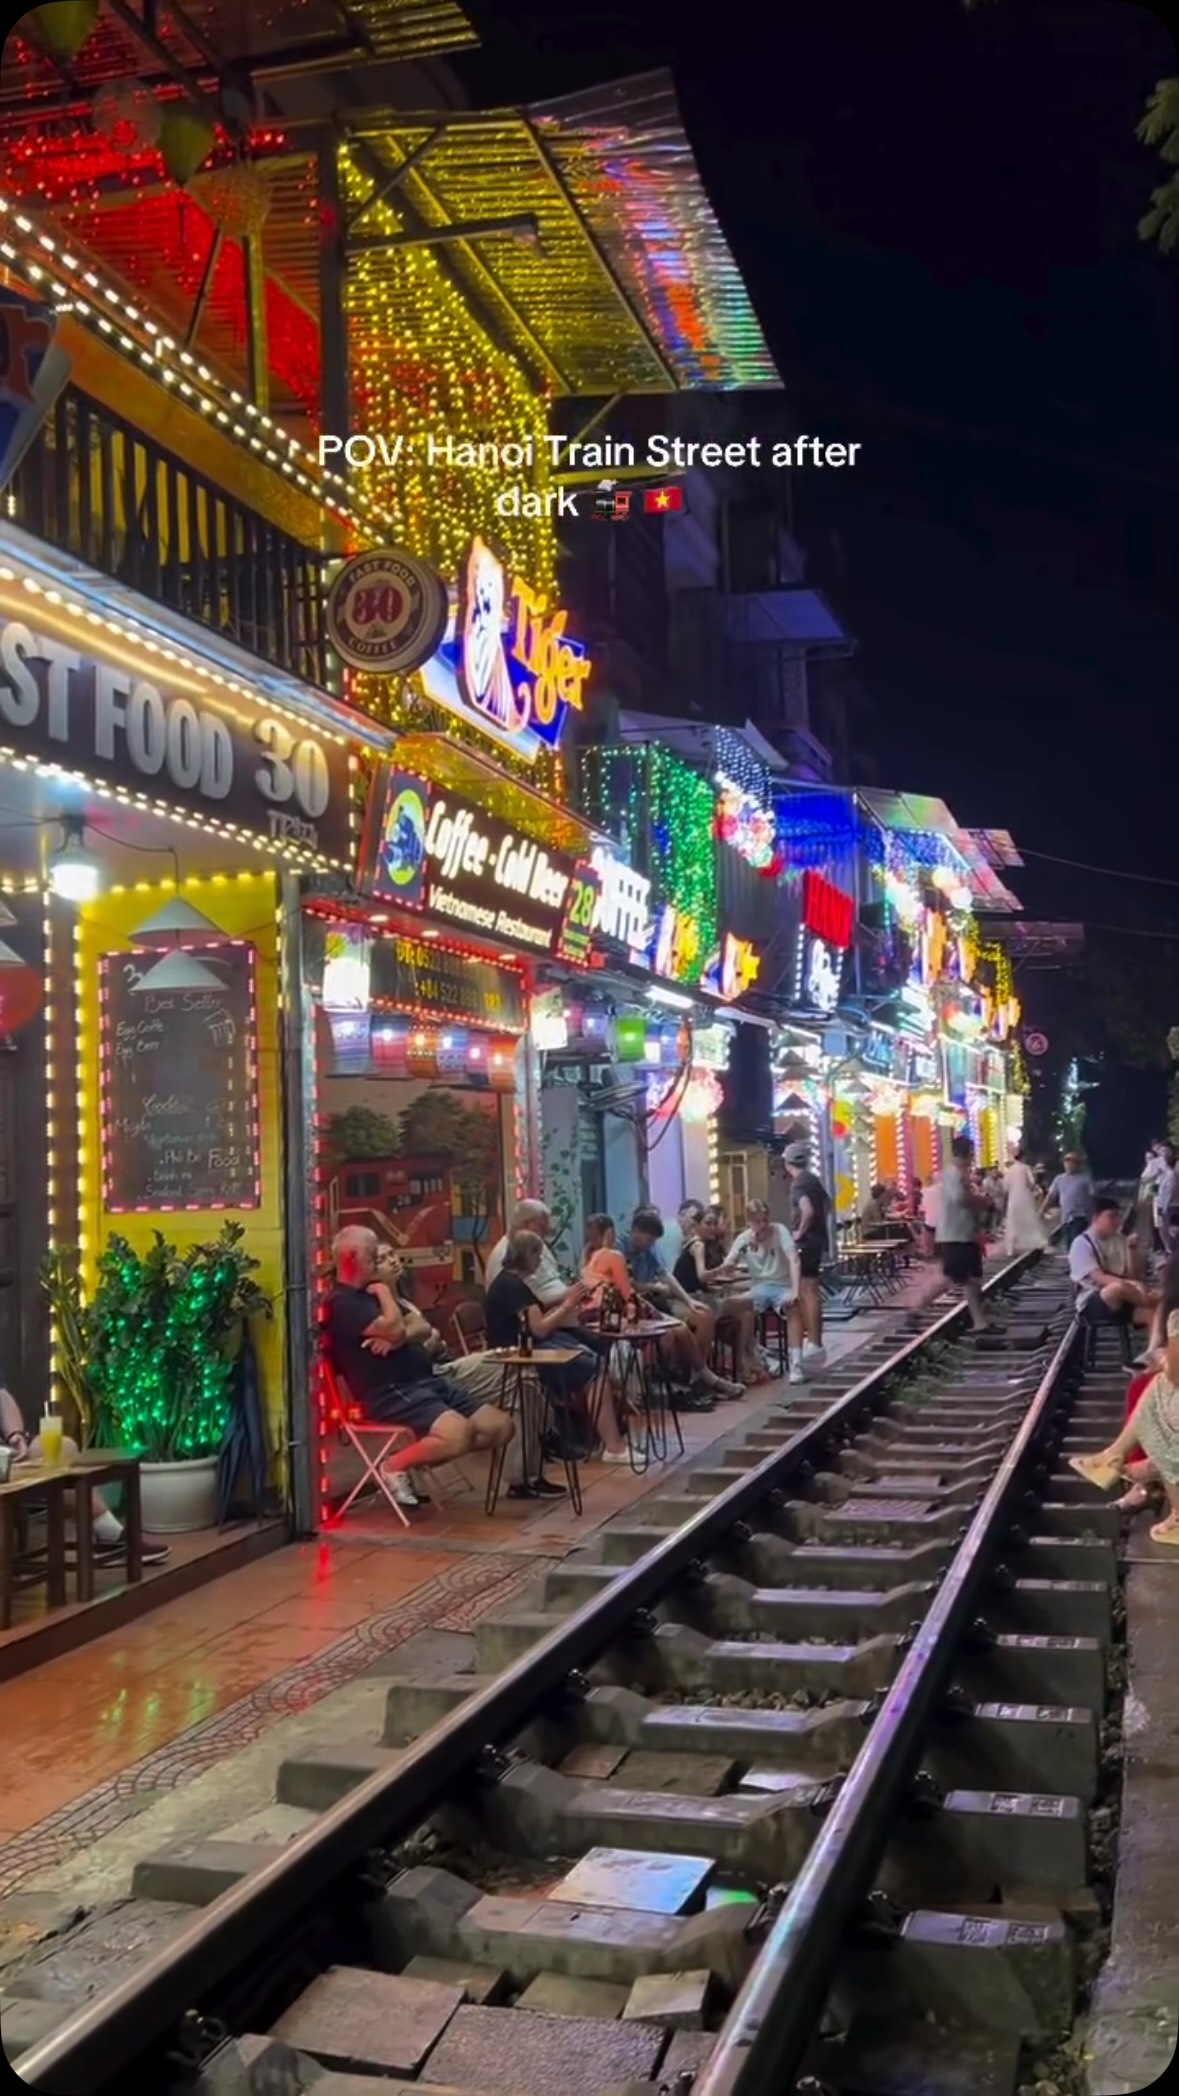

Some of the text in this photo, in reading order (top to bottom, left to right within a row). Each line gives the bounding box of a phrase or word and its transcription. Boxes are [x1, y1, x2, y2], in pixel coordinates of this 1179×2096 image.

[349, 560, 416, 587] FAST FOOD
[347, 636, 397, 655] COFFEE
[511, 574, 591, 724] Tiger
[94, 661, 235, 800] FOOD
[254, 718, 330, 818] 30
[425, 800, 490, 880] Coffee
[429, 883, 496, 930] Vietnamese
[494, 910, 553, 948] Restaurant
[569, 880, 595, 928] 28
